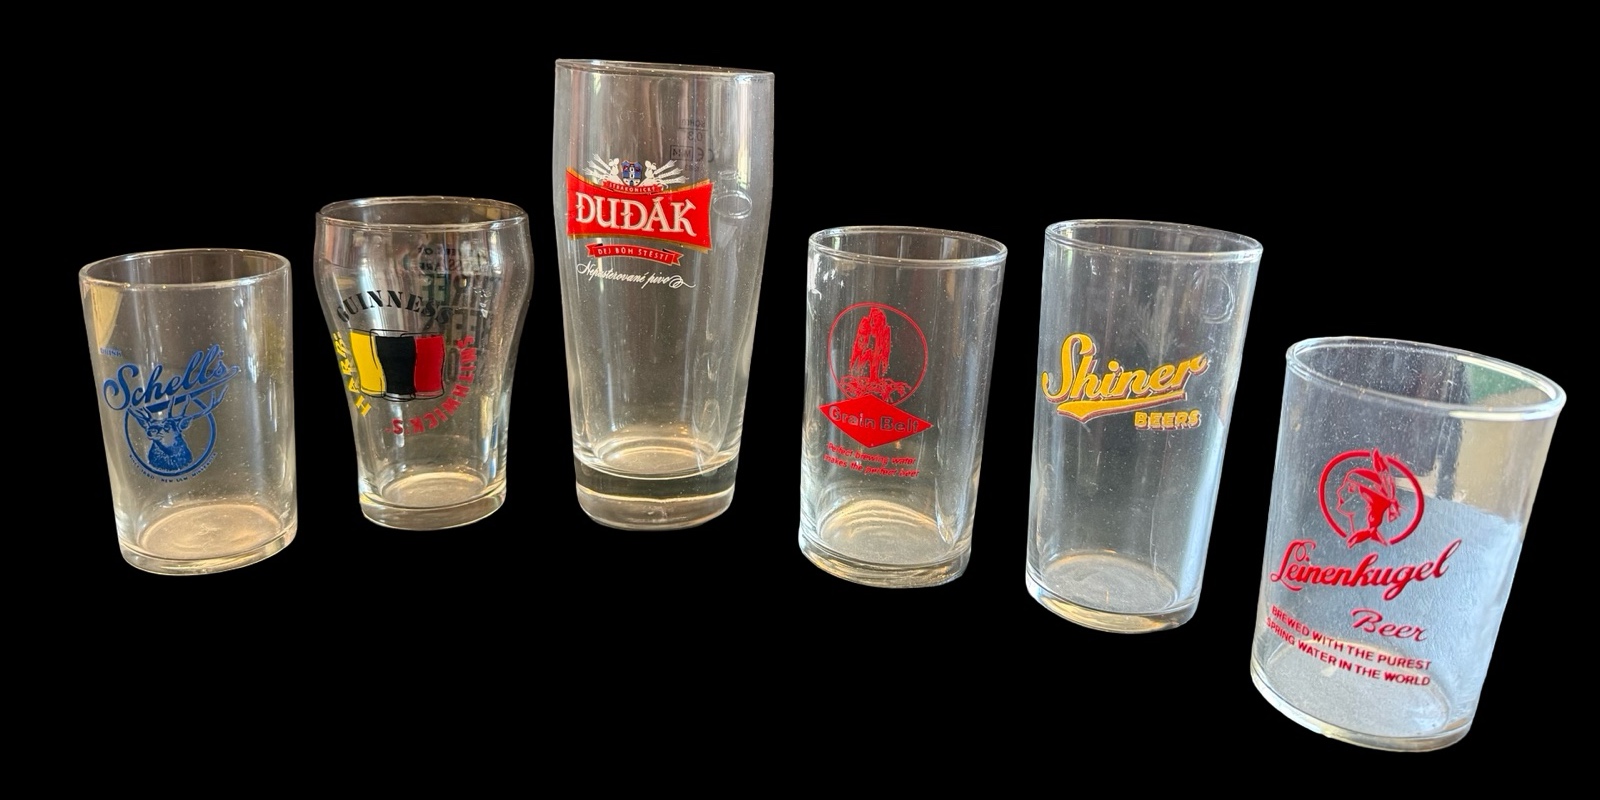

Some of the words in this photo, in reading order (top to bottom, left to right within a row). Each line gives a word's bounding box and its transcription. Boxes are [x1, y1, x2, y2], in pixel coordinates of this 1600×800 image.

[640, 271, 696, 289] pivo
[336, 289, 453, 325] GUINNESS
[103, 344, 228, 411] Schell's
[1041, 332, 1211, 402] Shiner
[828, 405, 875, 429] Grain
[880, 416, 919, 433] Belt
[1134, 409, 1201, 430] BEERS
[849, 459, 863, 472] the
[899, 467, 920, 478] beer
[855, 452, 889, 468] brewing
[891, 457, 917, 466] water
[1271, 539, 1462, 601] Leinenkugel
[1272, 605, 1310, 636] BREWED
[1312, 631, 1343, 652] WITH
[1347, 645, 1374, 661] THE
[1377, 654, 1432, 670] PUREST
[1352, 608, 1427, 643] Beer
[1266, 617, 1295, 646] SPRING
[1298, 639, 1337, 666] WATER
[1339, 659, 1353, 671] IN
[1355, 664, 1381, 679] THE
[1384, 671, 1431, 686] WORLD
